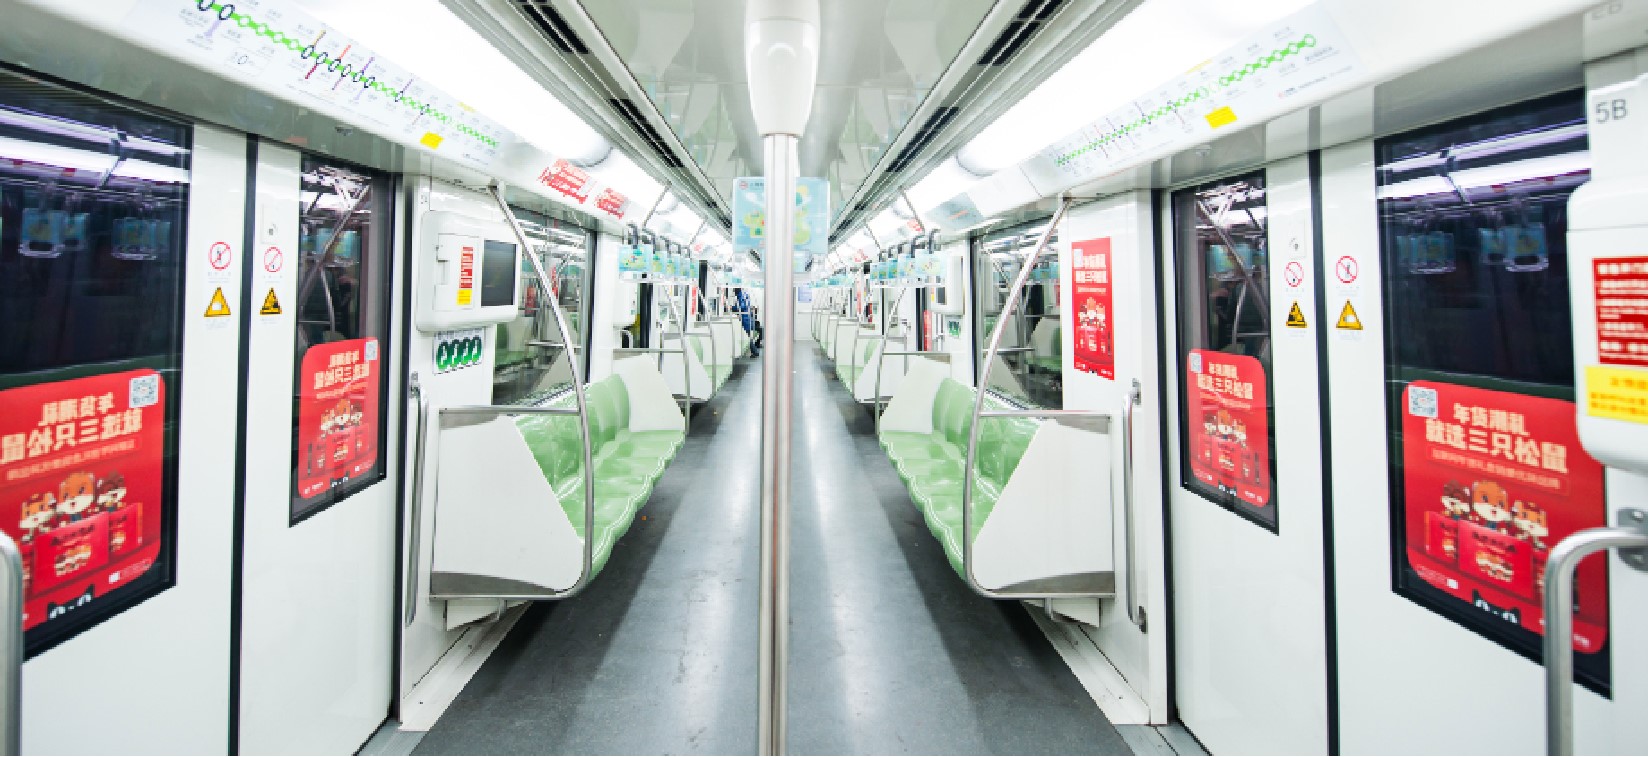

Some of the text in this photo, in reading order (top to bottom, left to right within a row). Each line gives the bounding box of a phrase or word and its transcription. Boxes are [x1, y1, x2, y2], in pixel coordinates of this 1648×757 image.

[1595, 98, 1628, 124] 5B
[1425, 417, 1569, 474] 就选三只松鼠
